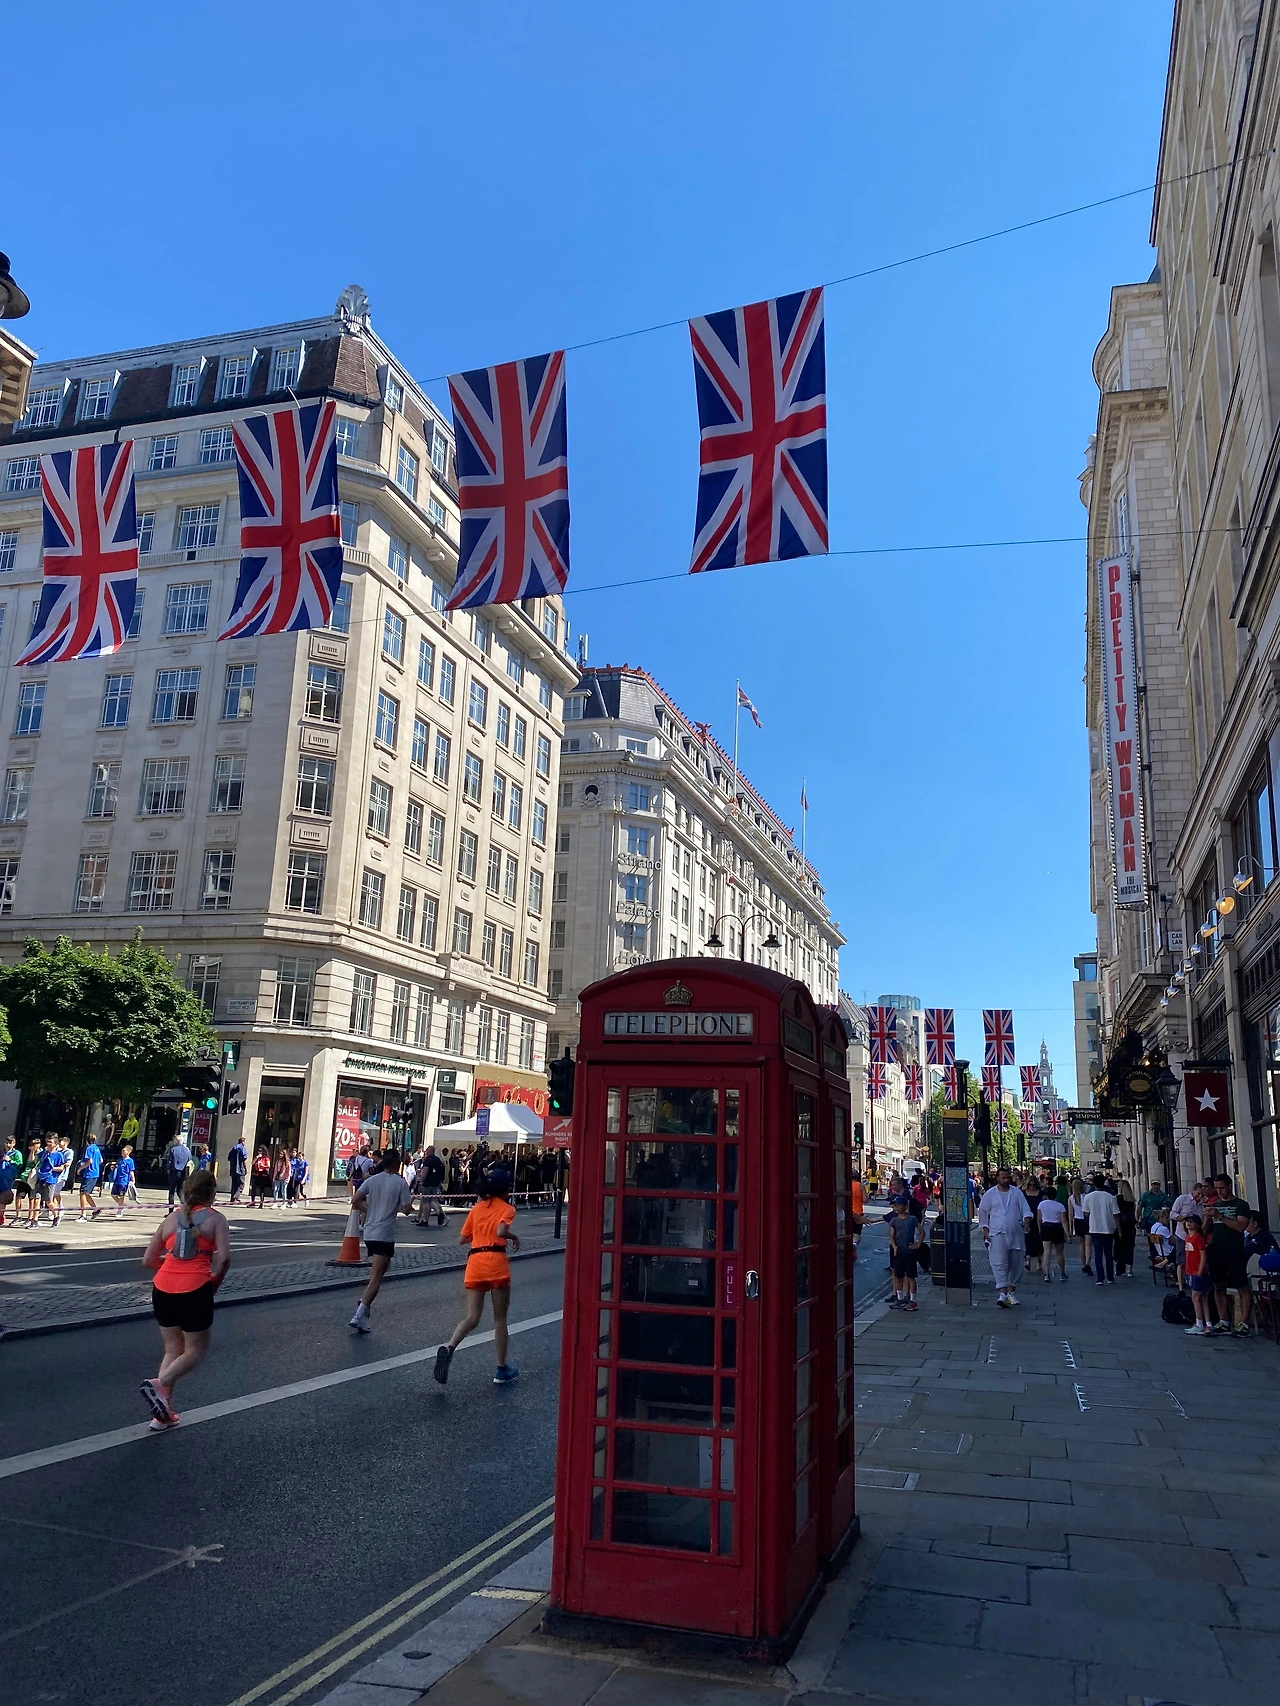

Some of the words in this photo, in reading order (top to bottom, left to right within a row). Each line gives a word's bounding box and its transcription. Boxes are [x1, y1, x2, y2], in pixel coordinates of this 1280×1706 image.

[1108, 565, 1127, 732] PRETTY
[1115, 739, 1136, 872] WOMAN
[617, 853, 662, 871] Strand
[1126, 876, 1135, 885] THE
[1120, 885, 1142, 895] MUSICAL
[616, 900, 661, 919] Palace
[609, 1015, 748, 1034] TELEPHONE
[338, 1105, 358, 1117] SALE
